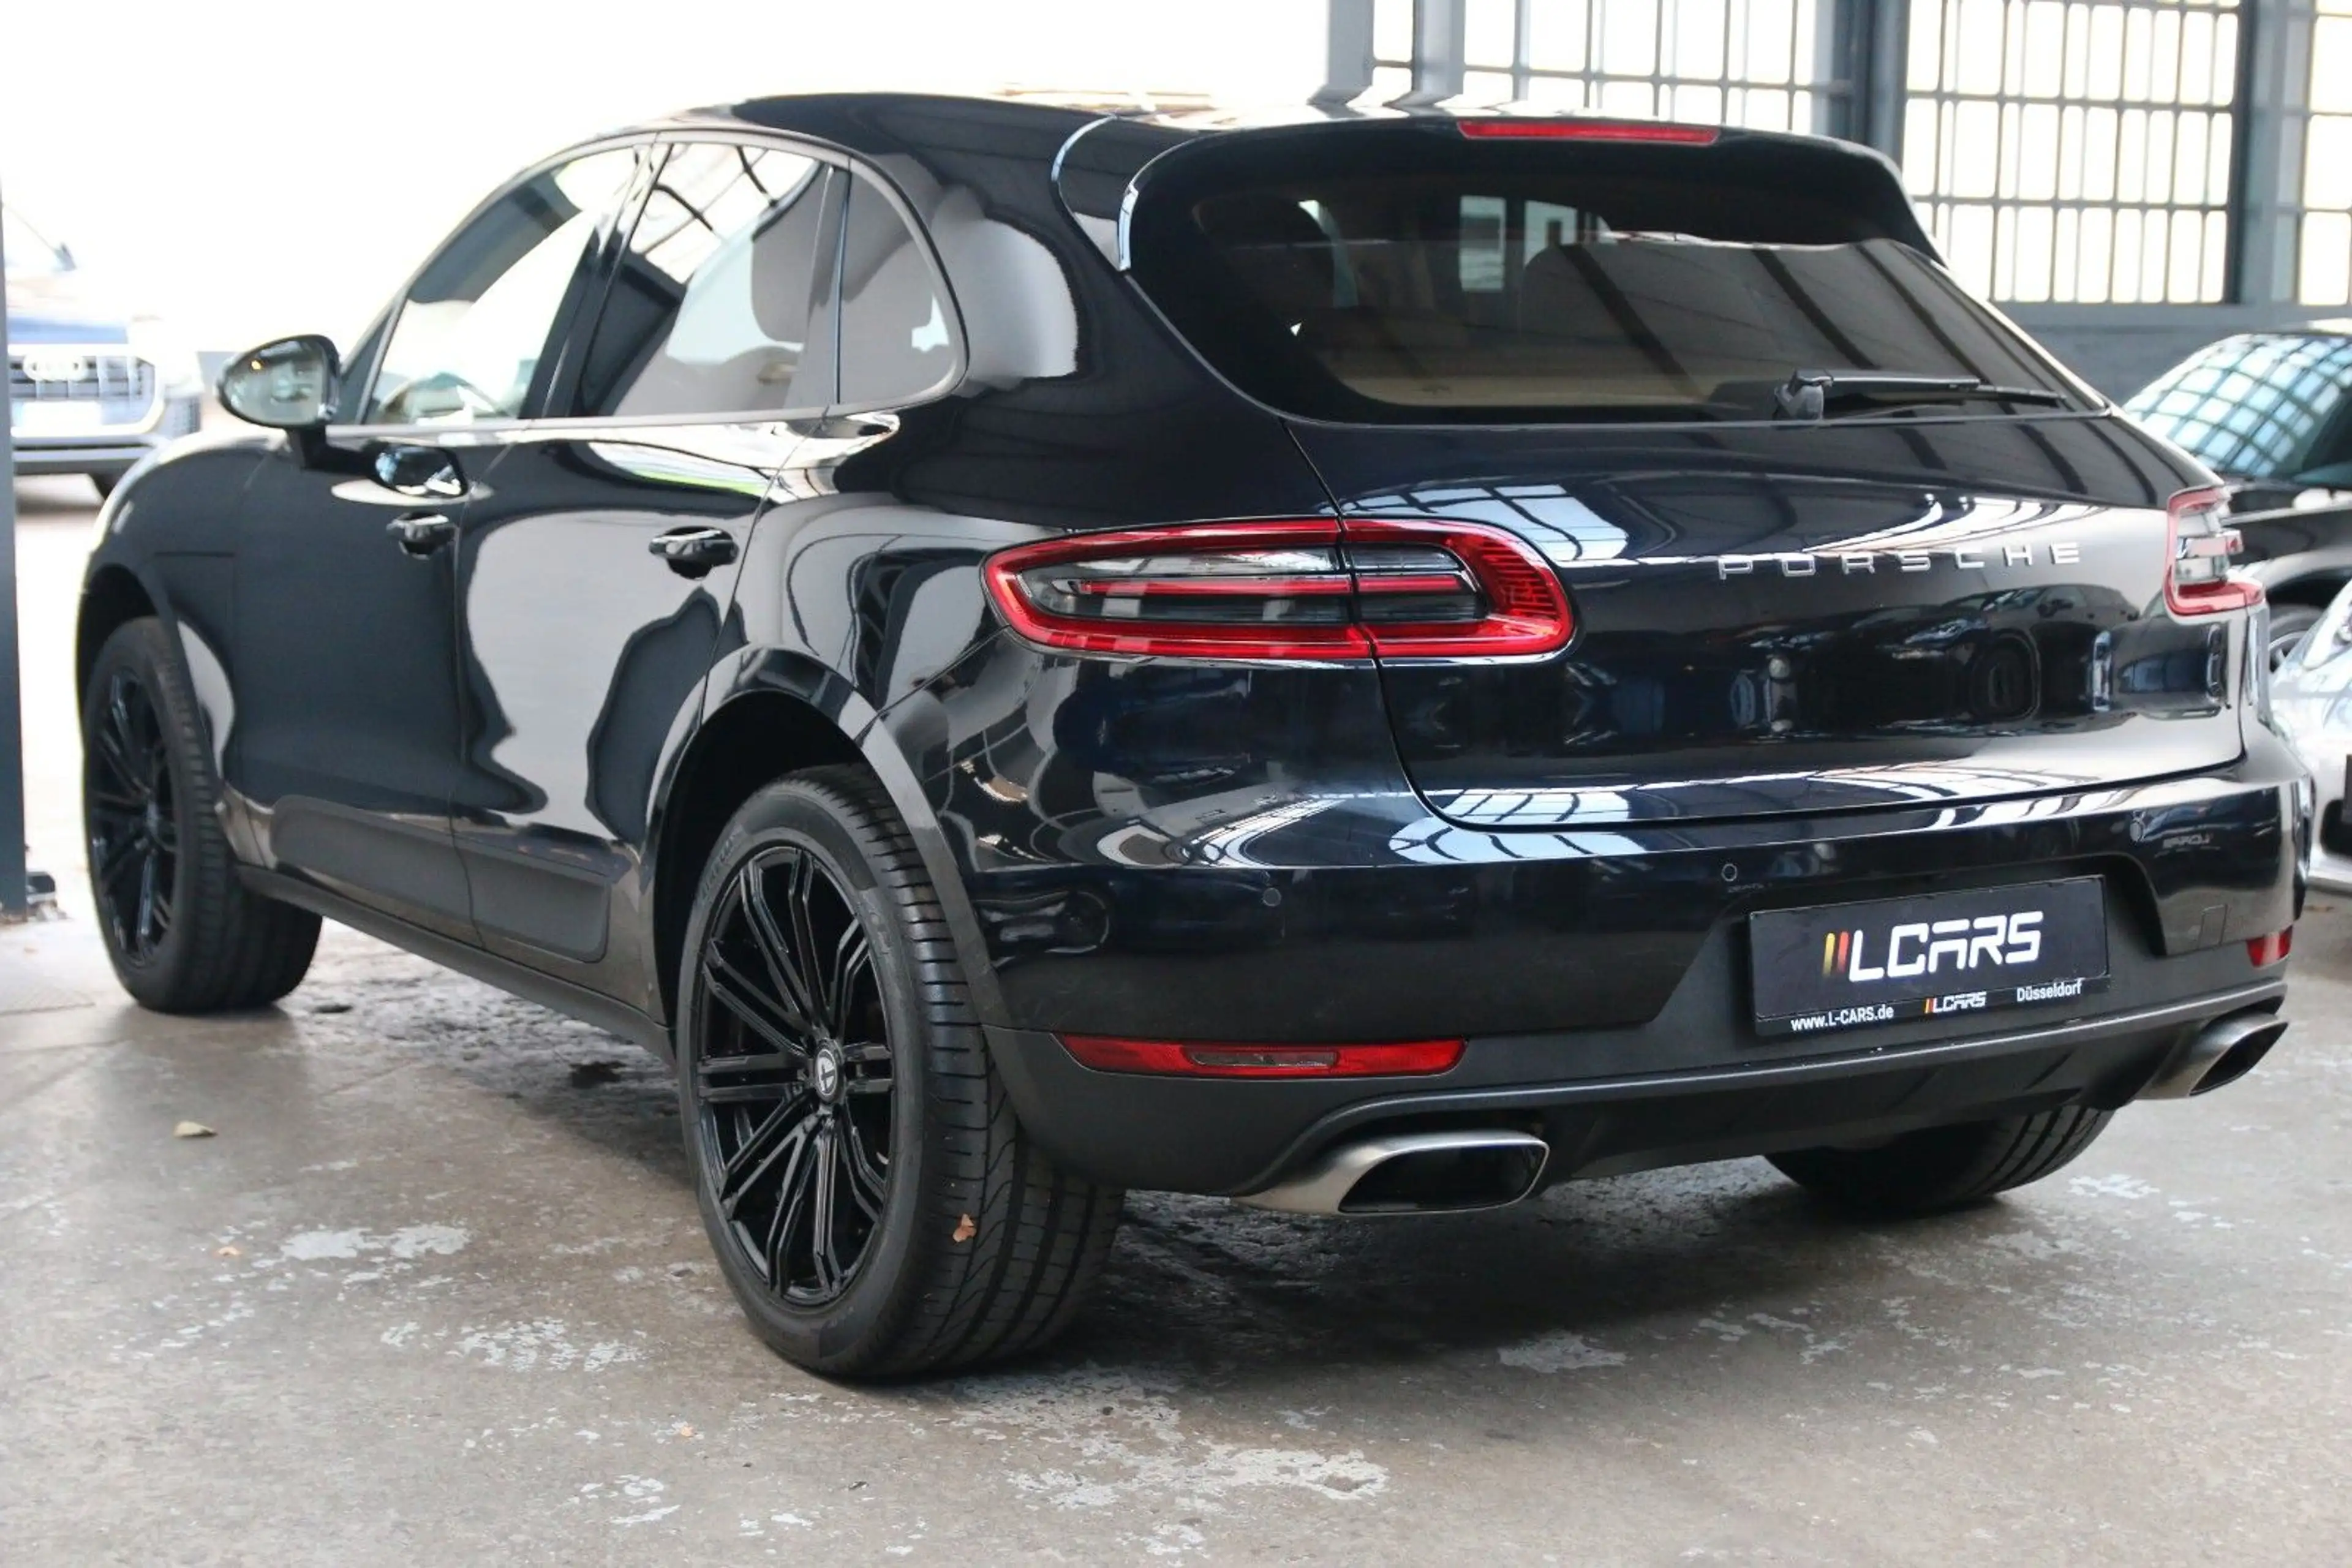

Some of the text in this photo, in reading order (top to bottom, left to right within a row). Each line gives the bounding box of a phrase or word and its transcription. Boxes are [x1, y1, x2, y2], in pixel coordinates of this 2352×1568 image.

[1718, 542, 2081, 579] PORSCHE
[1790, 1004, 1894, 1031] www.L-CARS.de
[2016, 978, 2084, 1003] Düsseldorf
